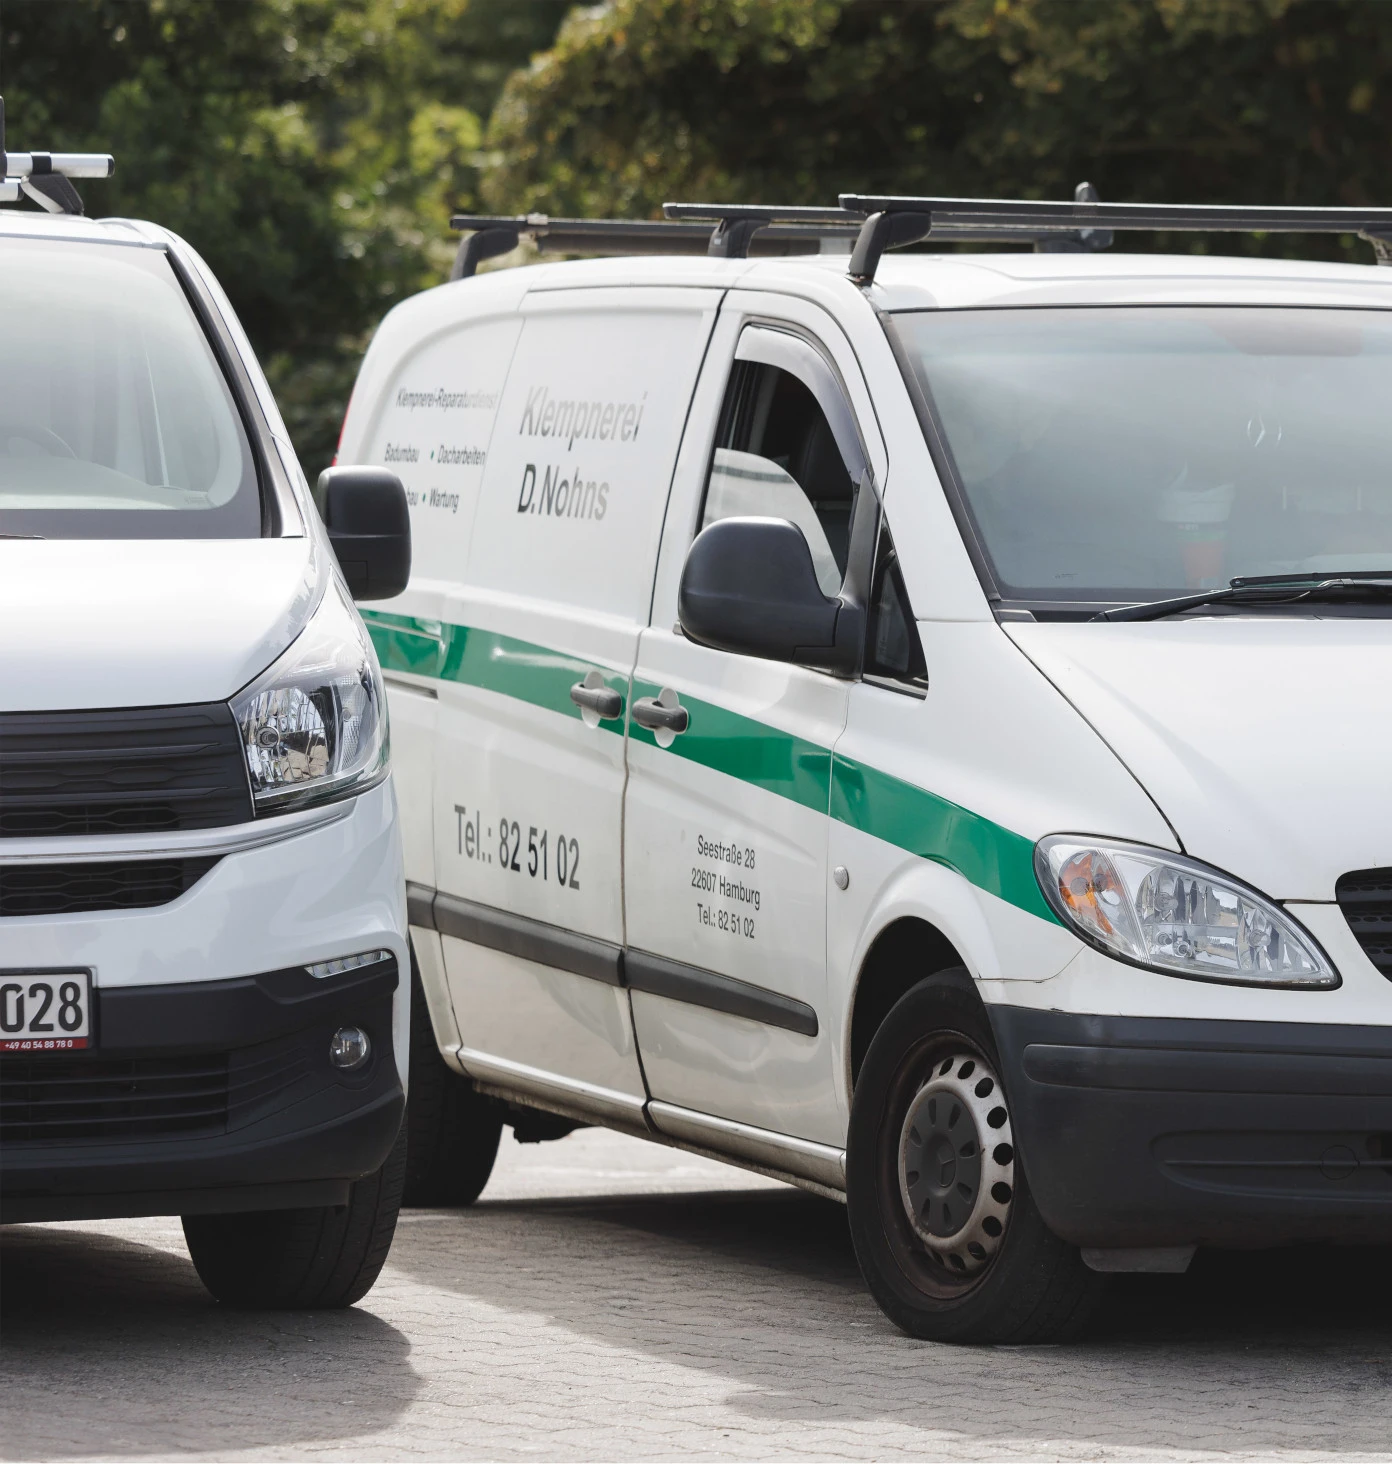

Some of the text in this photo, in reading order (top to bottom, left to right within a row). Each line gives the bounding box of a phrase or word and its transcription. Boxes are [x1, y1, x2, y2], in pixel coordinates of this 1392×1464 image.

[519, 386, 648, 451] Klempnerei
[437, 445, 486, 465] Dacharbeiten
[429, 488, 459, 514] Wartung
[454, 804, 580, 890] Tel.: 82 51 02
[697, 834, 756, 870] Seestraße 28
[691, 867, 761, 911] 22607 Hamburg
[697, 902, 755, 939] Tel.: 82 51 02
[0, 981, 83, 1033] 028
[4, 1041, 20, 1050] +49
